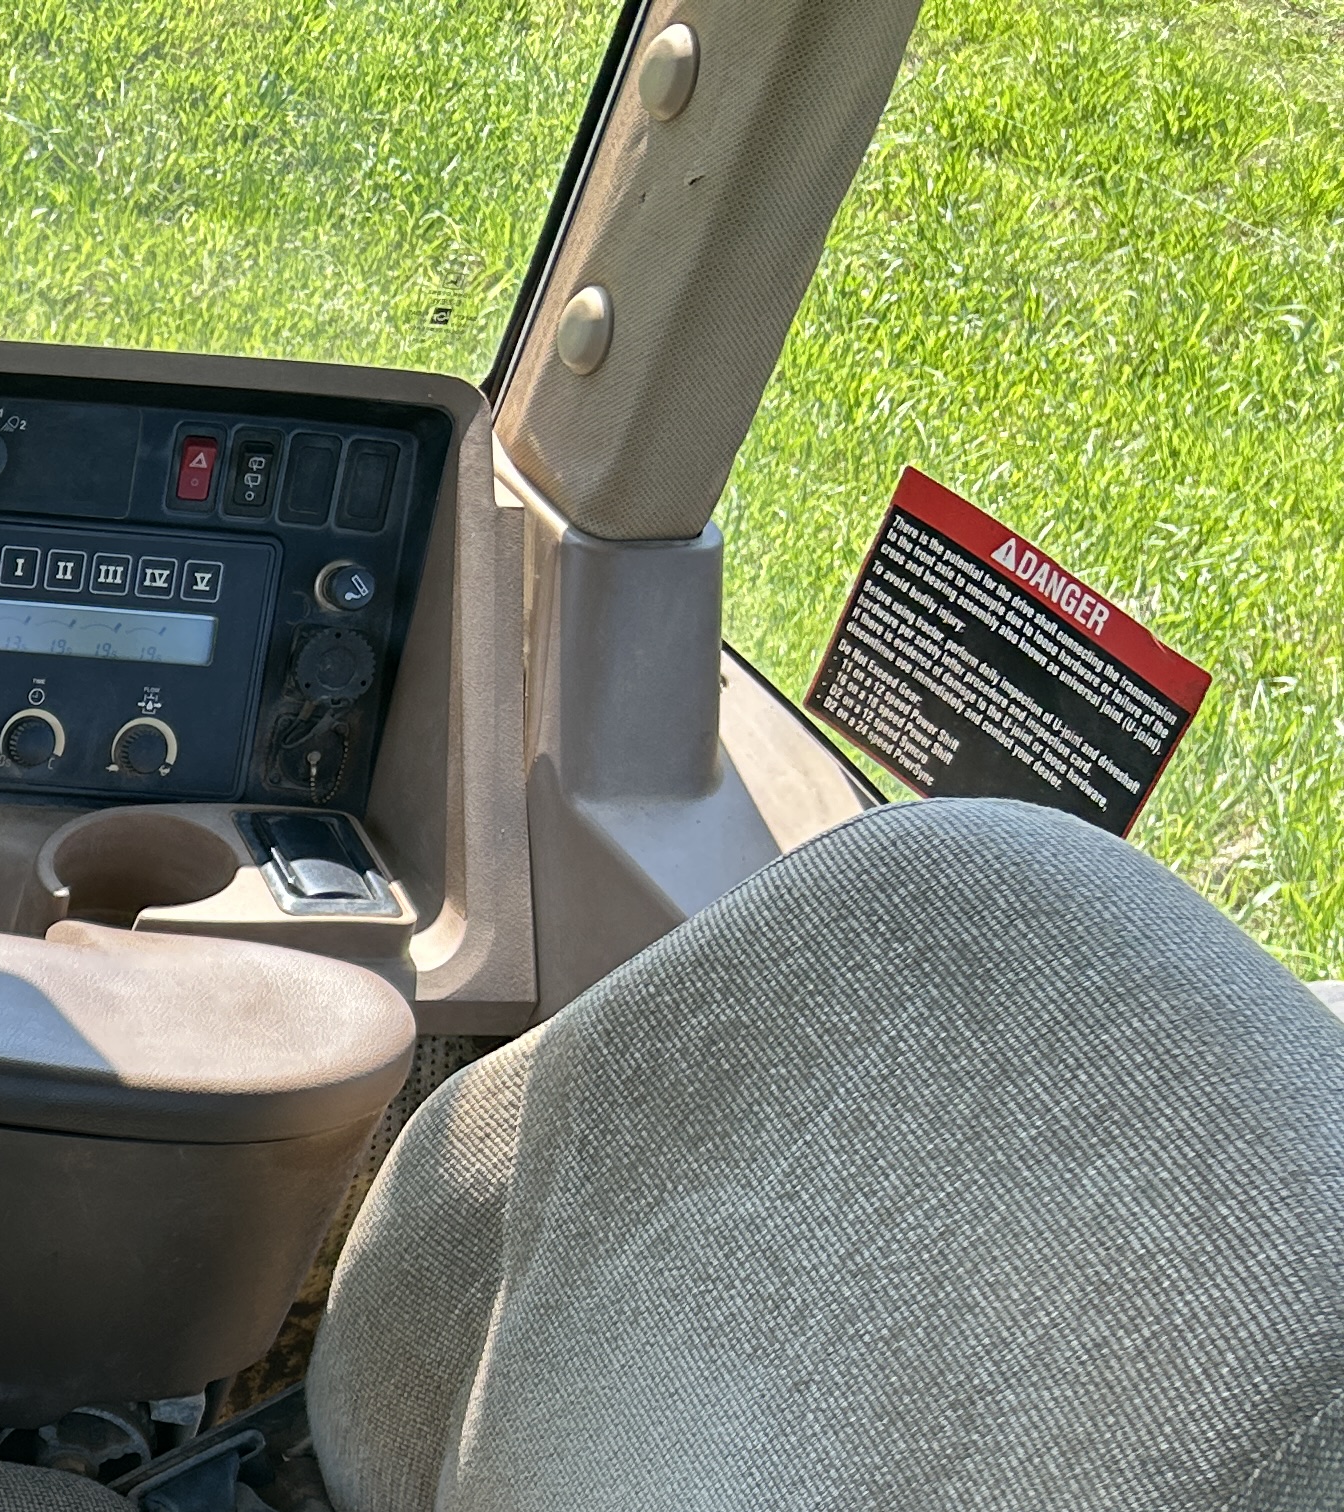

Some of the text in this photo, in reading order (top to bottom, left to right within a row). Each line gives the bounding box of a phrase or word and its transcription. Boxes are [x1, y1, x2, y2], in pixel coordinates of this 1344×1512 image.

[19, 420, 27, 430] 2
[14, 558, 25, 577] I
[55, 561, 75, 580] II
[97, 565, 124, 585] III
[143, 568, 170, 588] IV
[192, 572, 212, 591] V
[871, 559, 884, 575] To
[882, 569, 911, 593] avoid
[907, 584, 938, 614] bodily
[1015, 549, 1110, 636] DANGER
[880, 543, 906, 565] cross
[904, 559, 925, 578] and
[922, 568, 958, 603] bearing
[956, 594, 1000, 632] assembly
[997, 624, 1020, 645] also
[1017, 636, 1049, 667] known
[1045, 661, 1060, 676] as
[1058, 669, 1103, 708] universal
[1098, 698, 1124, 724] joint
[886, 527, 1169, 739] to the front axle to uncouple due to loose hardware or failure of the
[892, 513, 1178, 726] There is the potential for the drive shaft connecting the transmission
[837, 637, 923, 707] Do Not Exceed Gear:
[840, 657, 960, 752] 11 on a 12 speed Power Shift
[845, 620, 896, 662] discontinue
[894, 655, 913, 674] use
[911, 665, 966, 714] immediately
[963, 707, 984, 726] and
[980, 719, 1015, 750] contact
[1011, 743, 1035, 765] your
[851, 605, 1107, 811] If there is evidence of damage to the U-joint or loose hardware,
[856, 592, 900, 629] hardware
[896, 623, 916, 640] per
[913, 634, 943, 661] safety
[939, 651, 966, 676] letter
[962, 670, 1009, 709] procedure
[1007, 703, 1028, 722] and
[1024, 715, 1071, 758] inspection
[862, 578, 893, 607] Before
[890, 600, 917, 626] using
[943, 638, 980, 669] perform
[977, 661, 1001, 686] daily
[998, 676, 1044, 718] inspection
[1041, 711, 1055, 725] of
[1051, 716, 1084, 749] U-joint
[1080, 741, 1101, 761] and
[1097, 754, 1141, 795] driveshaft
[822, 695, 839, 713] D2
[835, 707, 849, 722] on
[847, 716, 856, 727] a
[854, 719, 870, 736] 24
[866, 730, 895, 755] speed
[828, 682, 844, 700] D2
[841, 694, 855, 709] on
[853, 703, 862, 714] a
[861, 707, 875, 724] 12
[872, 717, 901, 742] speed
[835, 670, 849, 686] 16
[846, 680, 860, 695] on
[857, 689, 866, 701] a
[876, 703, 907, 729] speed
[903, 720, 933, 749] Power
[930, 741, 954, 766] Shift
